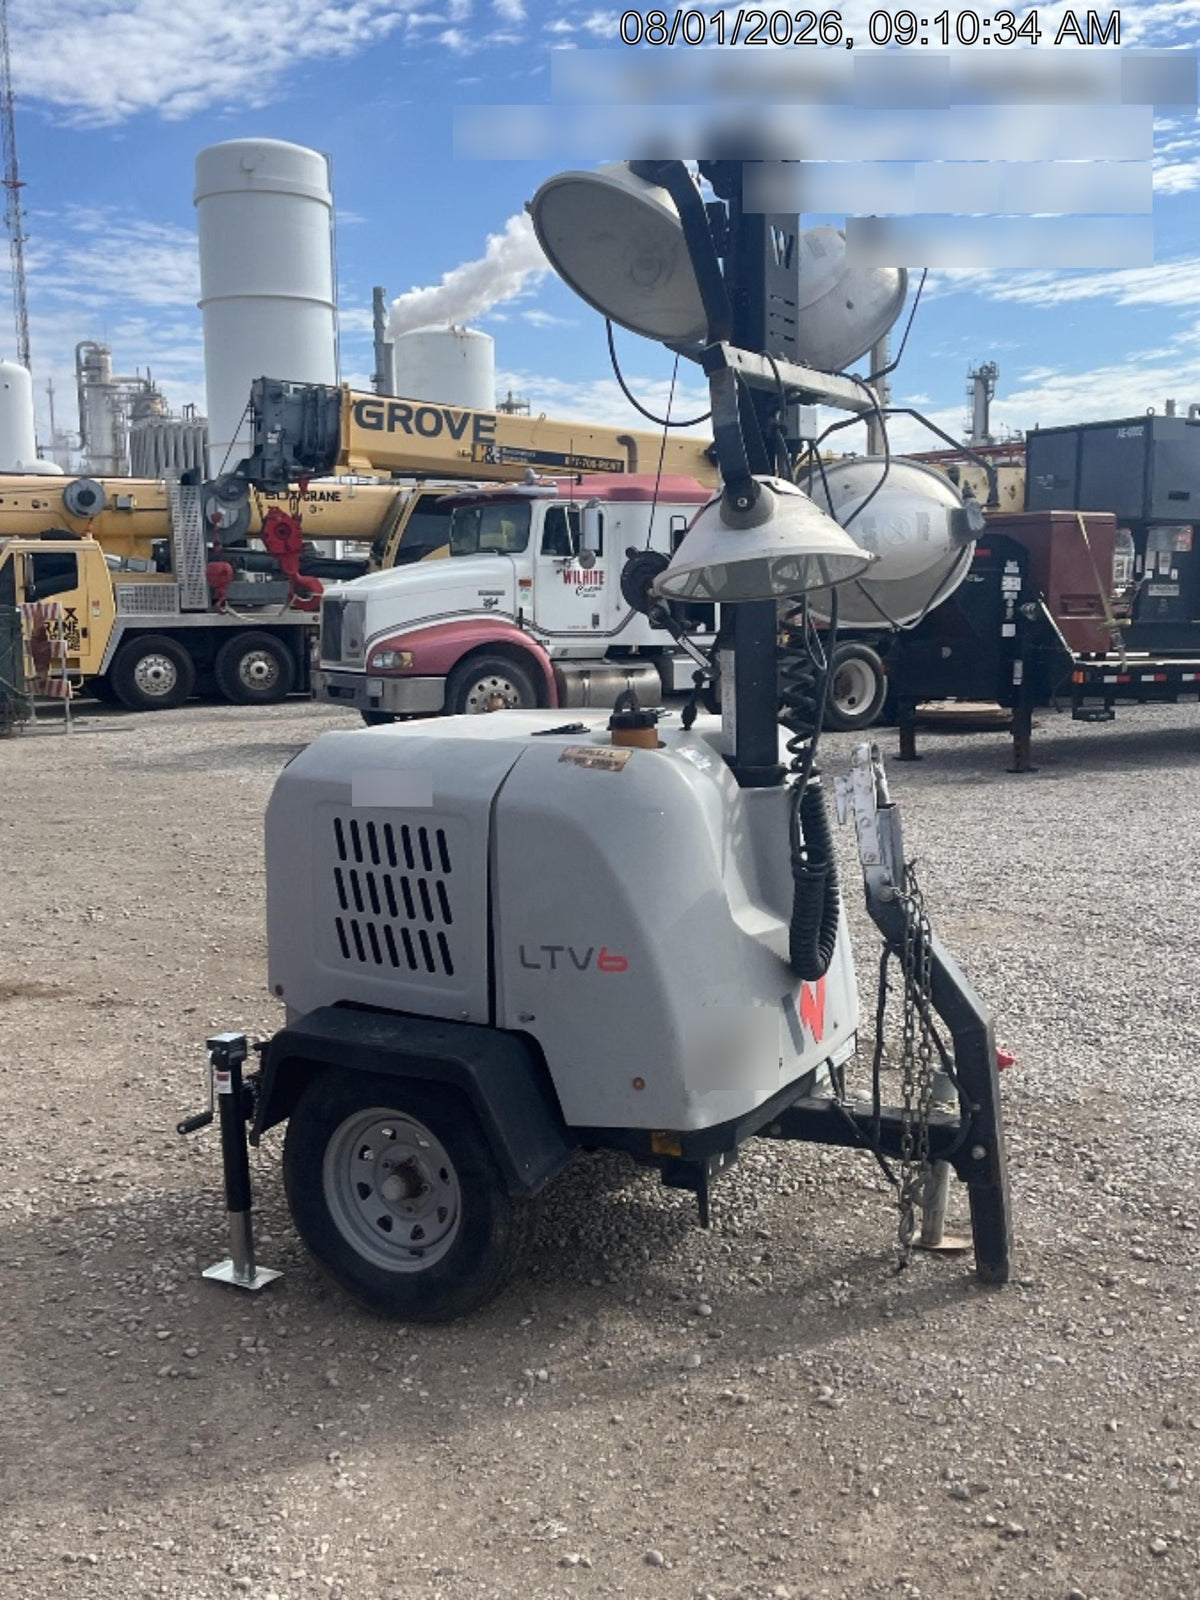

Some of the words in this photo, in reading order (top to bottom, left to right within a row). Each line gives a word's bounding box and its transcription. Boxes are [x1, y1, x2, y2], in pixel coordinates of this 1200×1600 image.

[354, 399, 497, 444] GROVE
[562, 569, 605, 585] WILHITE
[518, 943, 629, 972] LTV6
